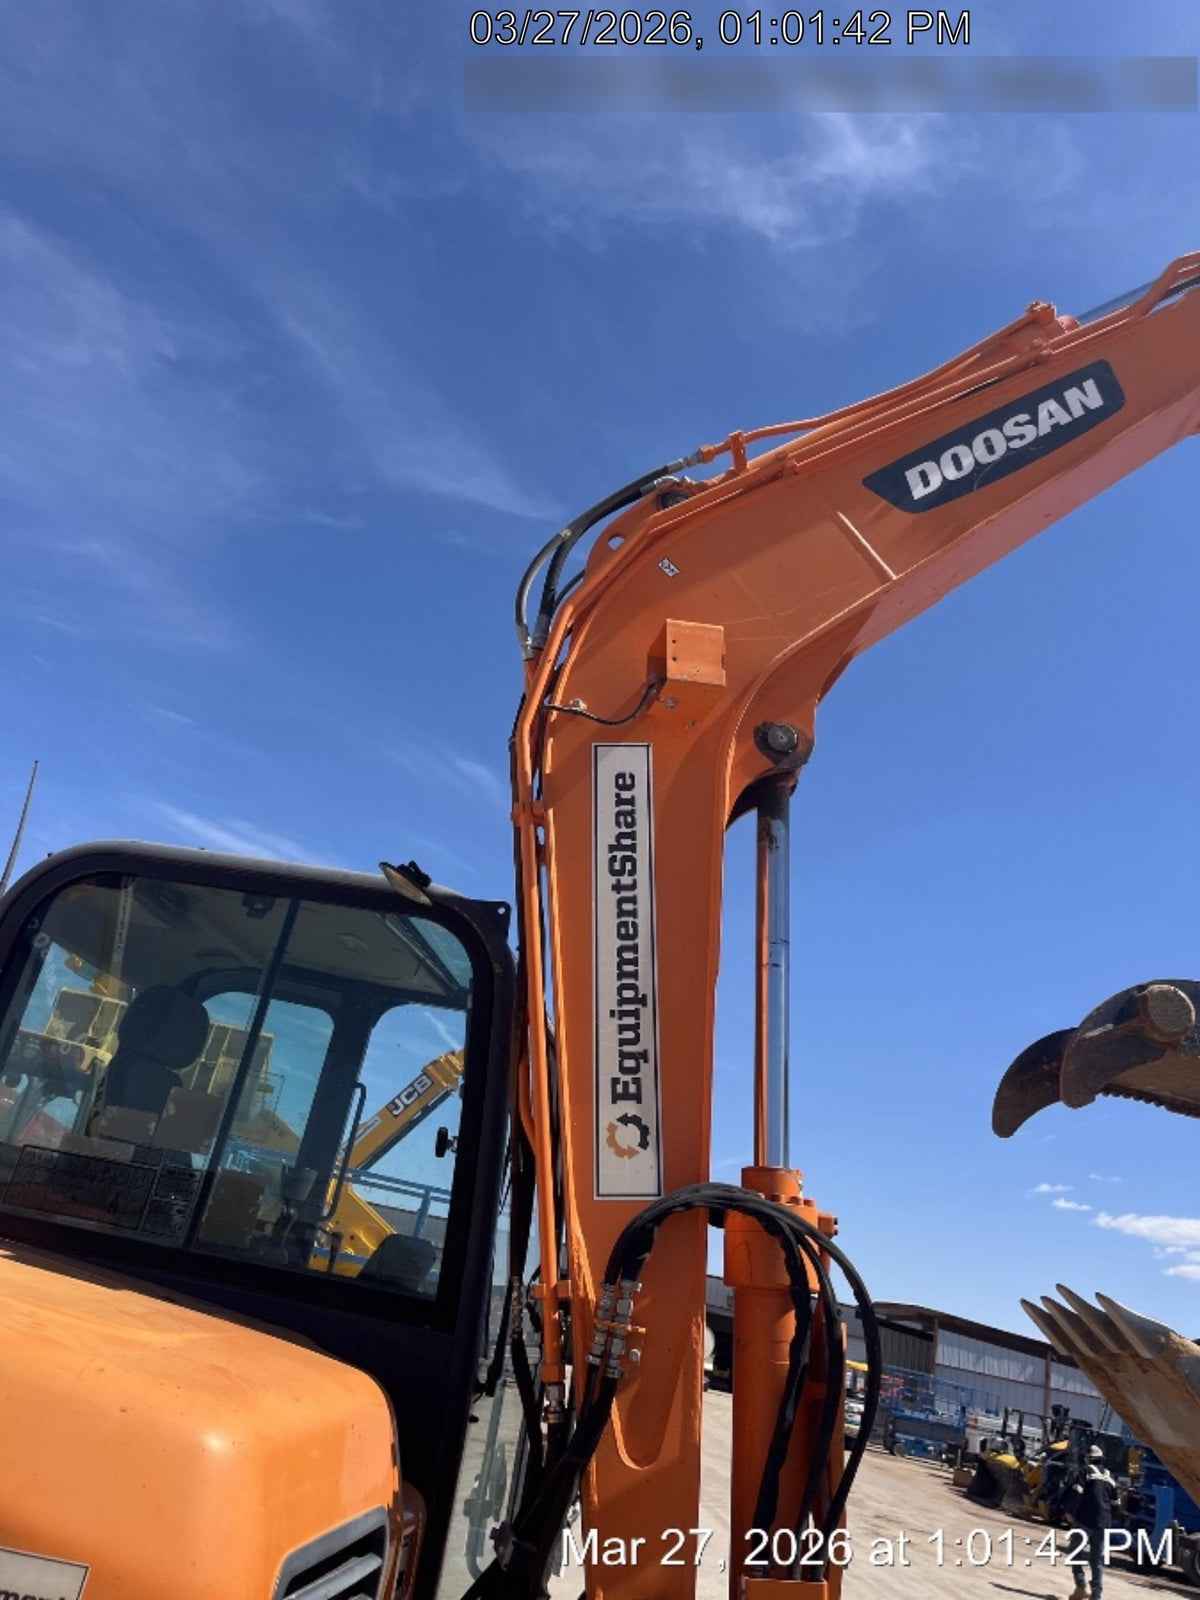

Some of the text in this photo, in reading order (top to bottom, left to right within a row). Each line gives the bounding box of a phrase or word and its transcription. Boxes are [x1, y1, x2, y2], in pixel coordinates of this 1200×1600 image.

[904, 378, 1104, 500] DOOSAN
[608, 771, 650, 1105] EquipmentShare
[391, 1074, 434, 1116] JCB
